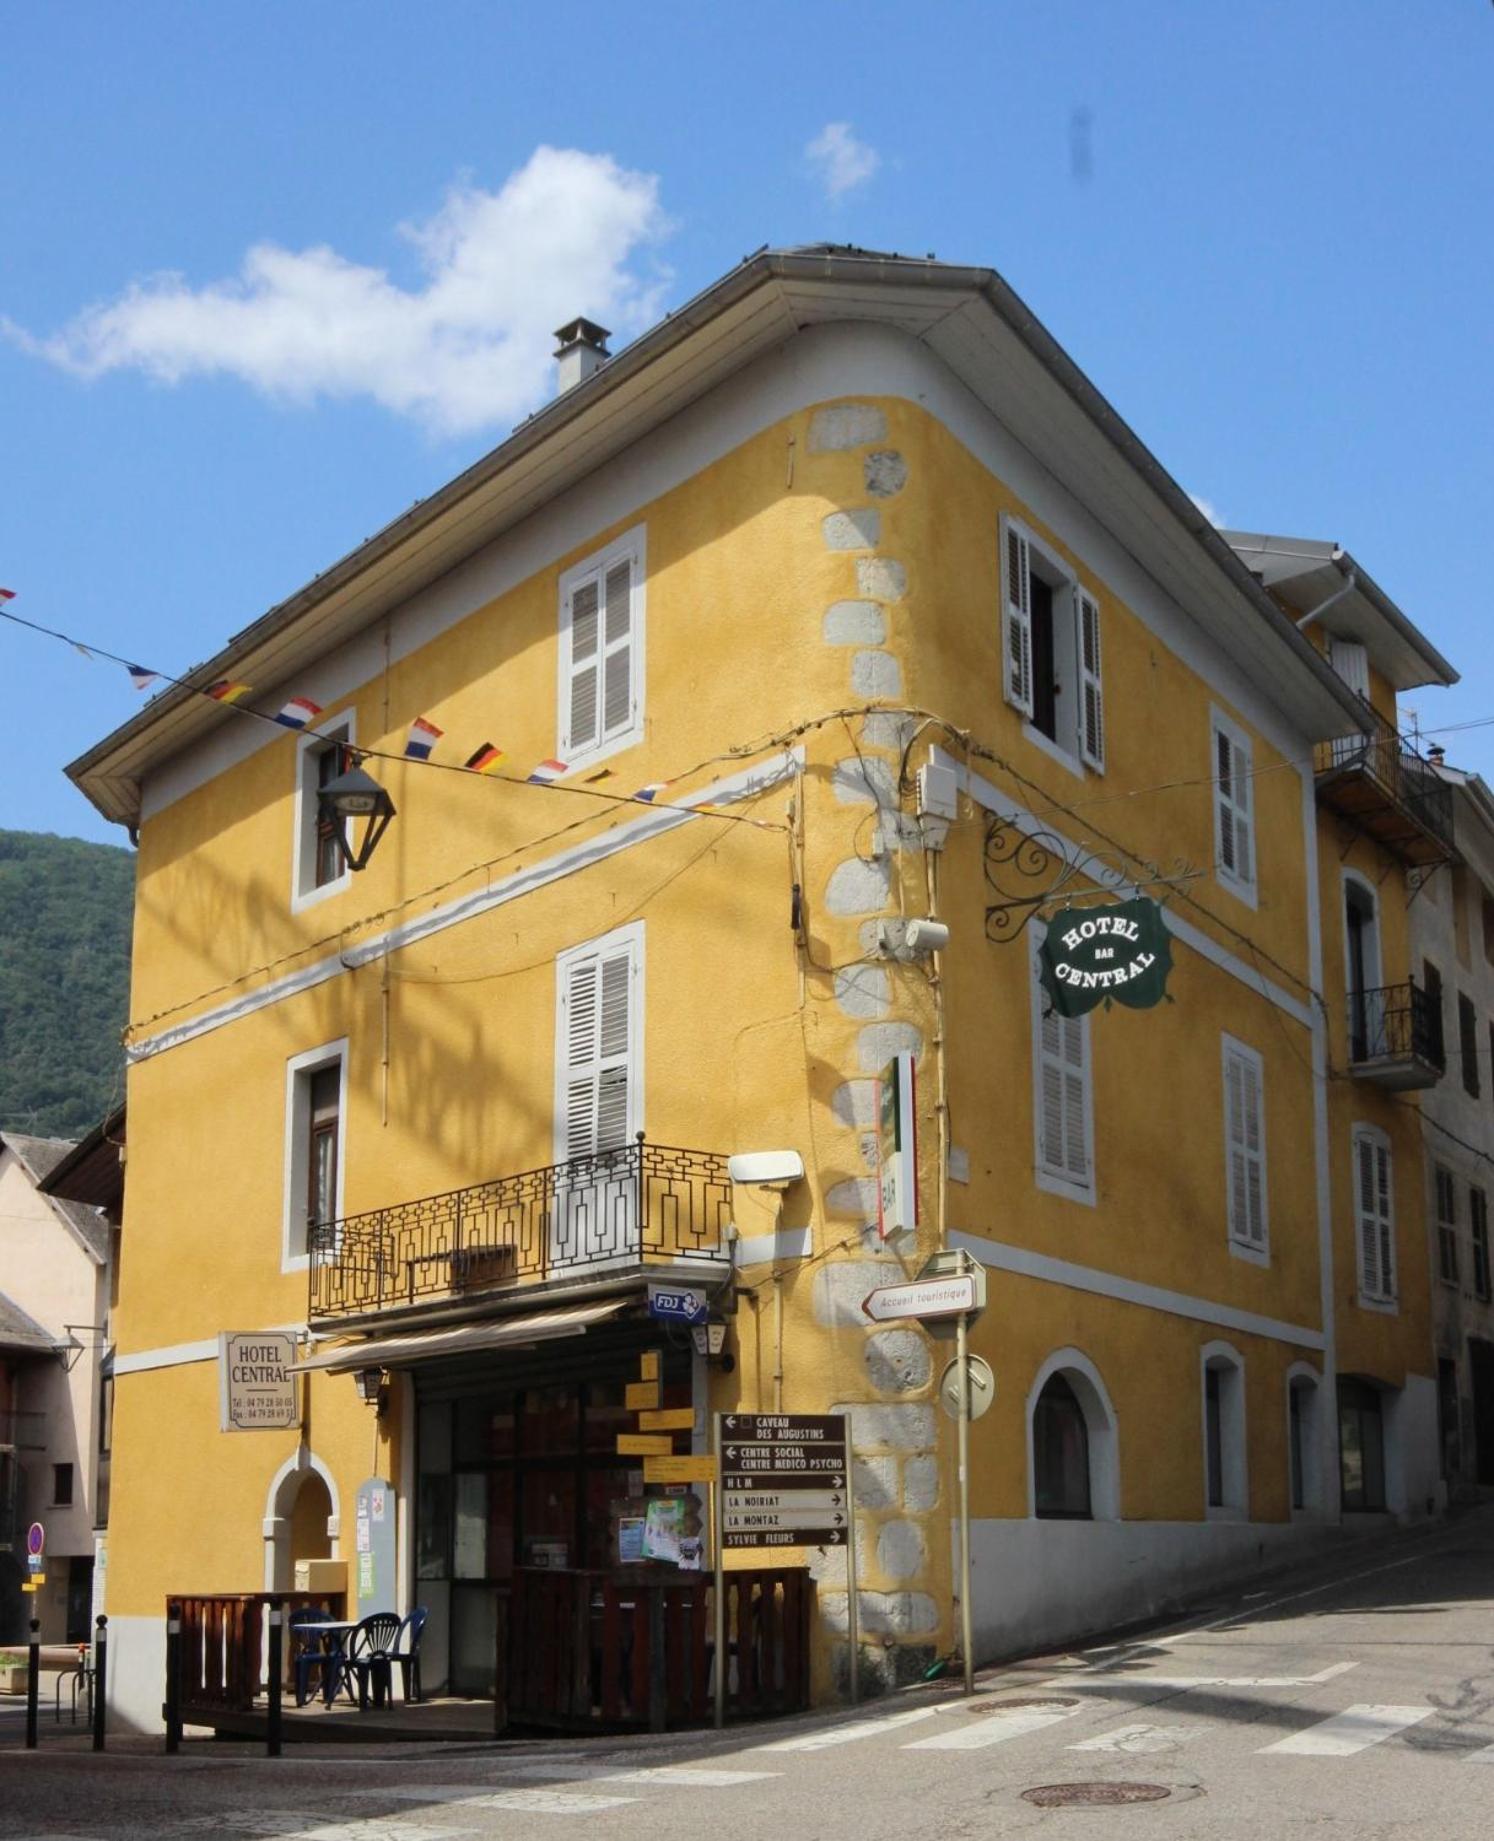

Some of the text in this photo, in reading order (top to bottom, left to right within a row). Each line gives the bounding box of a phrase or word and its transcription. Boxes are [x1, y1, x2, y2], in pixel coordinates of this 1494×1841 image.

[1061, 916, 1139, 951] HOTEL
[1094, 947, 1115, 960] BAR
[1055, 952, 1156, 988] CENTRAL
[657, 1295, 678, 1309] FDJ
[880, 1288, 967, 1307] Accueil touristique
[240, 1346, 281, 1363] HOTEL
[232, 1366, 290, 1382] CENTRAL
[756, 1417, 789, 1428] CAVEAU
[756, 1429, 824, 1439] DES AUGUSTINS
[740, 1447, 804, 1458] CENTRE SOCIAL
[740, 1458, 843, 1469] CENTRE MEDICO PSYCHO
[728, 1497, 740, 1507] LA
[728, 1515, 779, 1526] LA MONTAZ
[728, 1533, 794, 1545] SYLVIE FLEURS
